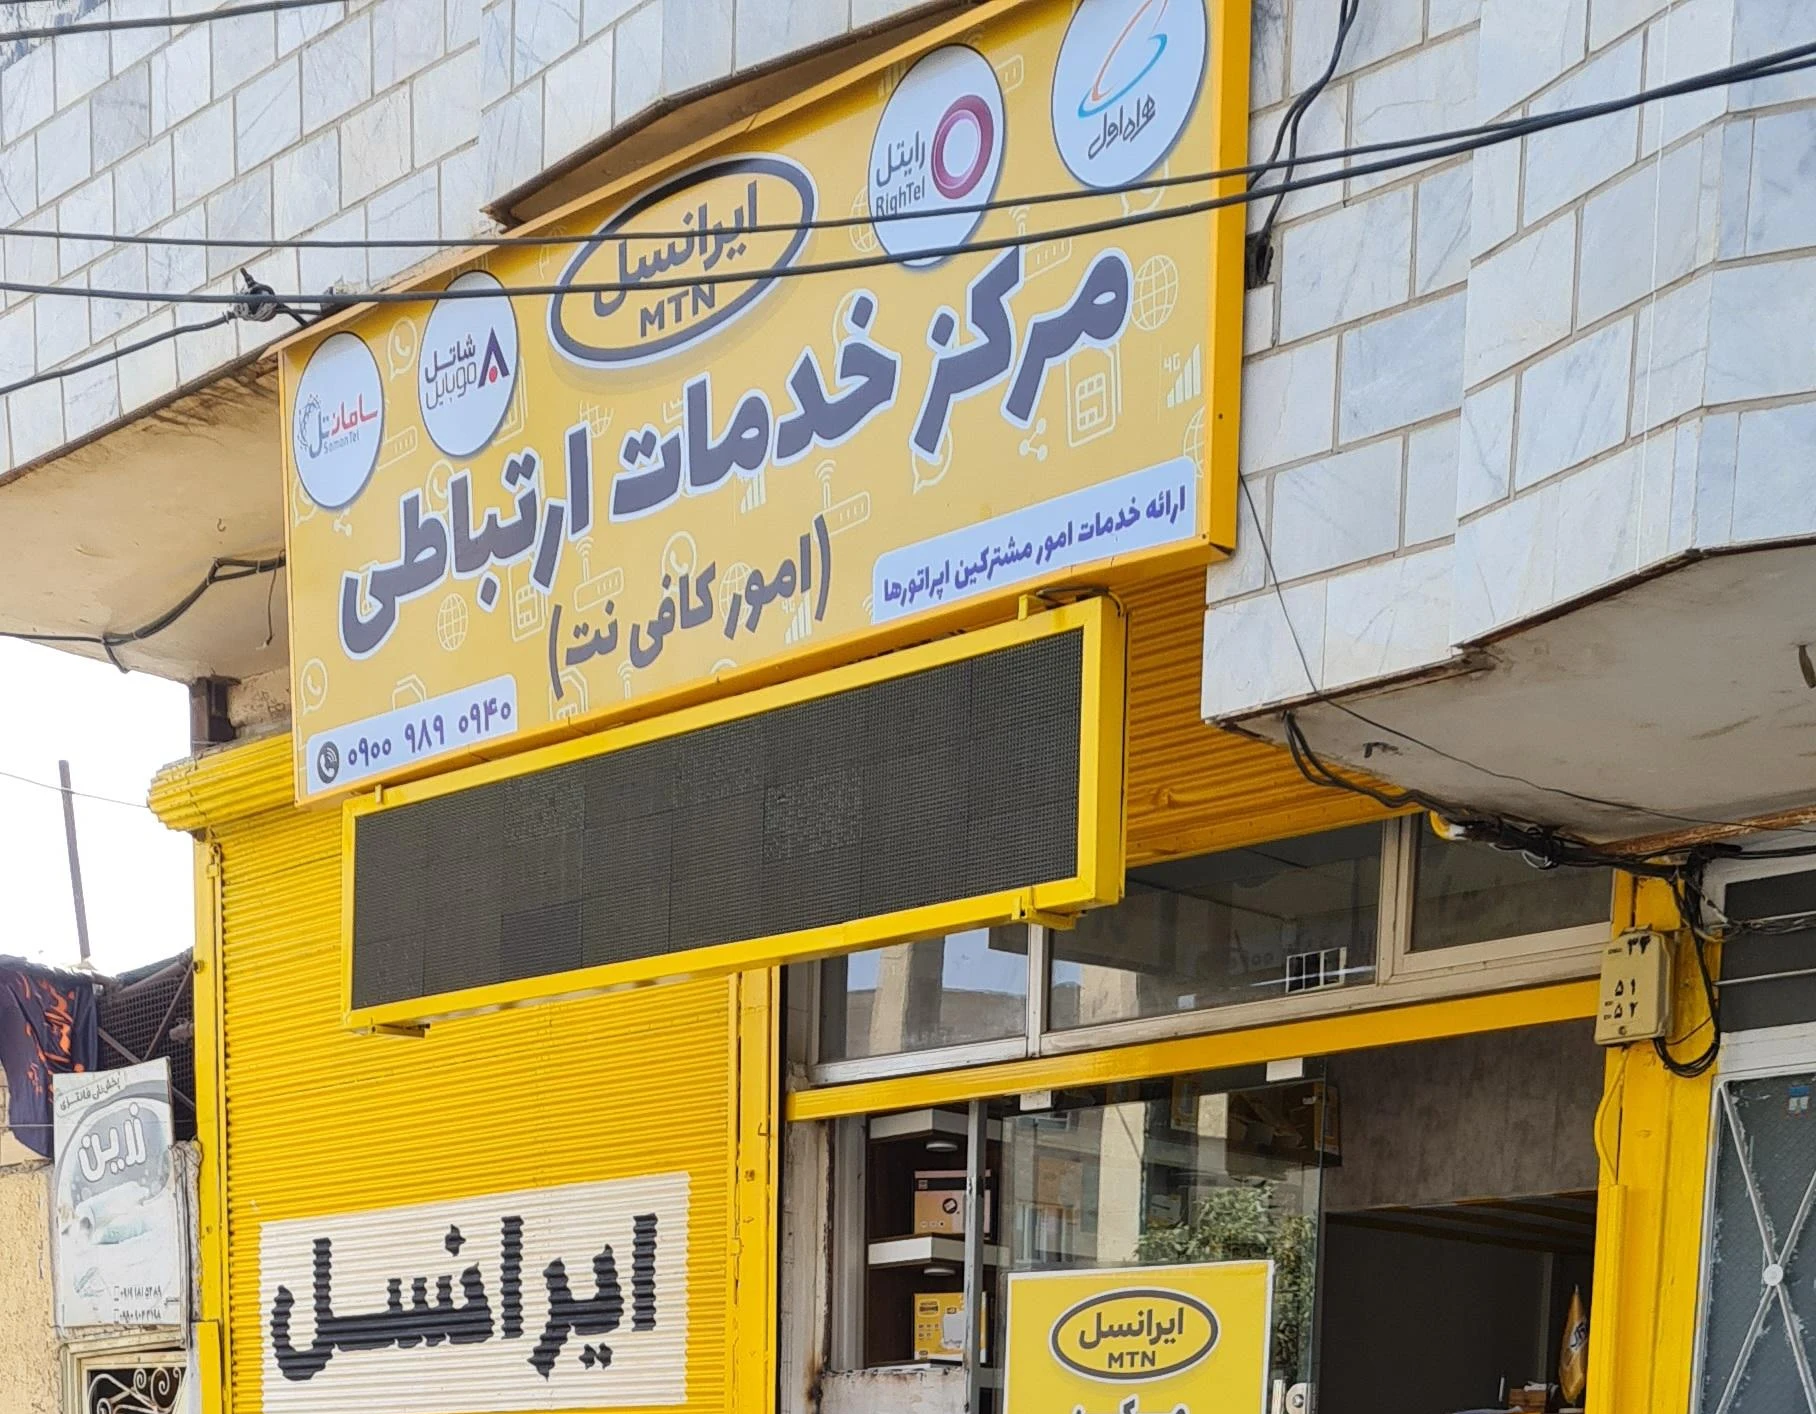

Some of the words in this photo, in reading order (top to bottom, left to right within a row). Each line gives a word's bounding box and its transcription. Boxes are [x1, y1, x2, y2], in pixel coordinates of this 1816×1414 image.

[876, 130, 925, 187] رایتل
[876, 176, 925, 217] RighTel
[593, 180, 758, 318] ایرانسل
[640, 282, 716, 338] MTN
[425, 333, 476, 384] شاتل
[915, 246, 1131, 455] مرکز
[425, 361, 478, 410] موبایل
[613, 294, 897, 516] خدمات
[308, 392, 379, 459] سامانتل
[1077, 497, 1140, 543] خدمات
[1146, 485, 1186, 524] ارائه
[343, 428, 590, 654] ارتباطی
[954, 537, 1032, 588] مشترکین
[1035, 521, 1073, 564] امور
[724, 514, 831, 640] (امور
[883, 560, 950, 607] اپراتورها
[629, 561, 716, 668] کافی
[549, 600, 618, 700] نت)
[348, 737, 392, 767] ۰۹۰۰
[404, 714, 445, 754] ۹۸۹
[458, 697, 512, 734] ۰۹۴۰
[270, 1212, 658, 1382] ایرانسل
[1079, 1307, 1184, 1349] ایرانسل
[1108, 1351, 1156, 1369] MTN
